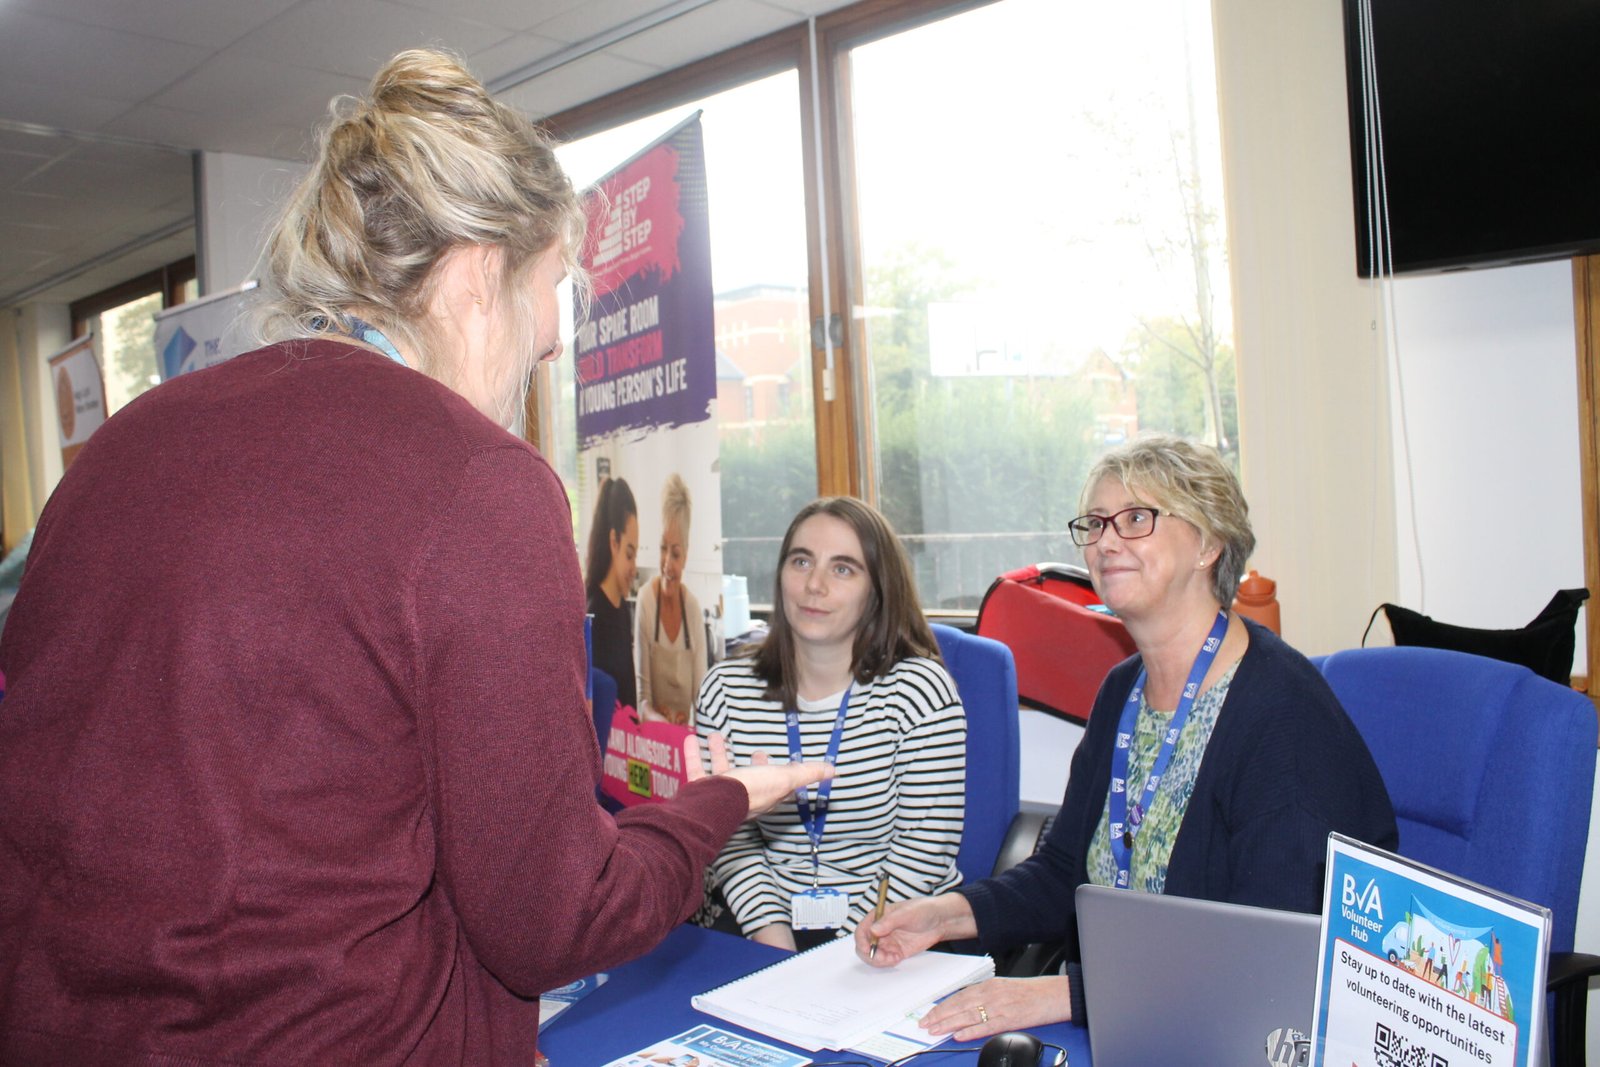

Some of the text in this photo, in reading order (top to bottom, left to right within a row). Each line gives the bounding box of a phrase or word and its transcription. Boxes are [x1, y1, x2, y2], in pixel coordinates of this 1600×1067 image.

[622, 176, 651, 209] STEP
[622, 206, 637, 229] BY
[623, 218, 652, 252] STEP
[599, 307, 628, 345] SPARE
[630, 294, 659, 334] ROOM
[585, 381, 616, 414] YOUNG
[616, 365, 664, 407] PERSON'S
[665, 357, 688, 395] LIFE
[674, 747, 681, 774] A
[629, 764, 650, 791] HERO
[652, 769, 680, 799] TODAY
[1342, 904, 1383, 934] Volunteer
[1351, 924, 1369, 943] Hub
[1340, 951, 1505, 1045] Stay up to date with the latest
[1346, 978, 1492, 1065] volunteering opportunities
